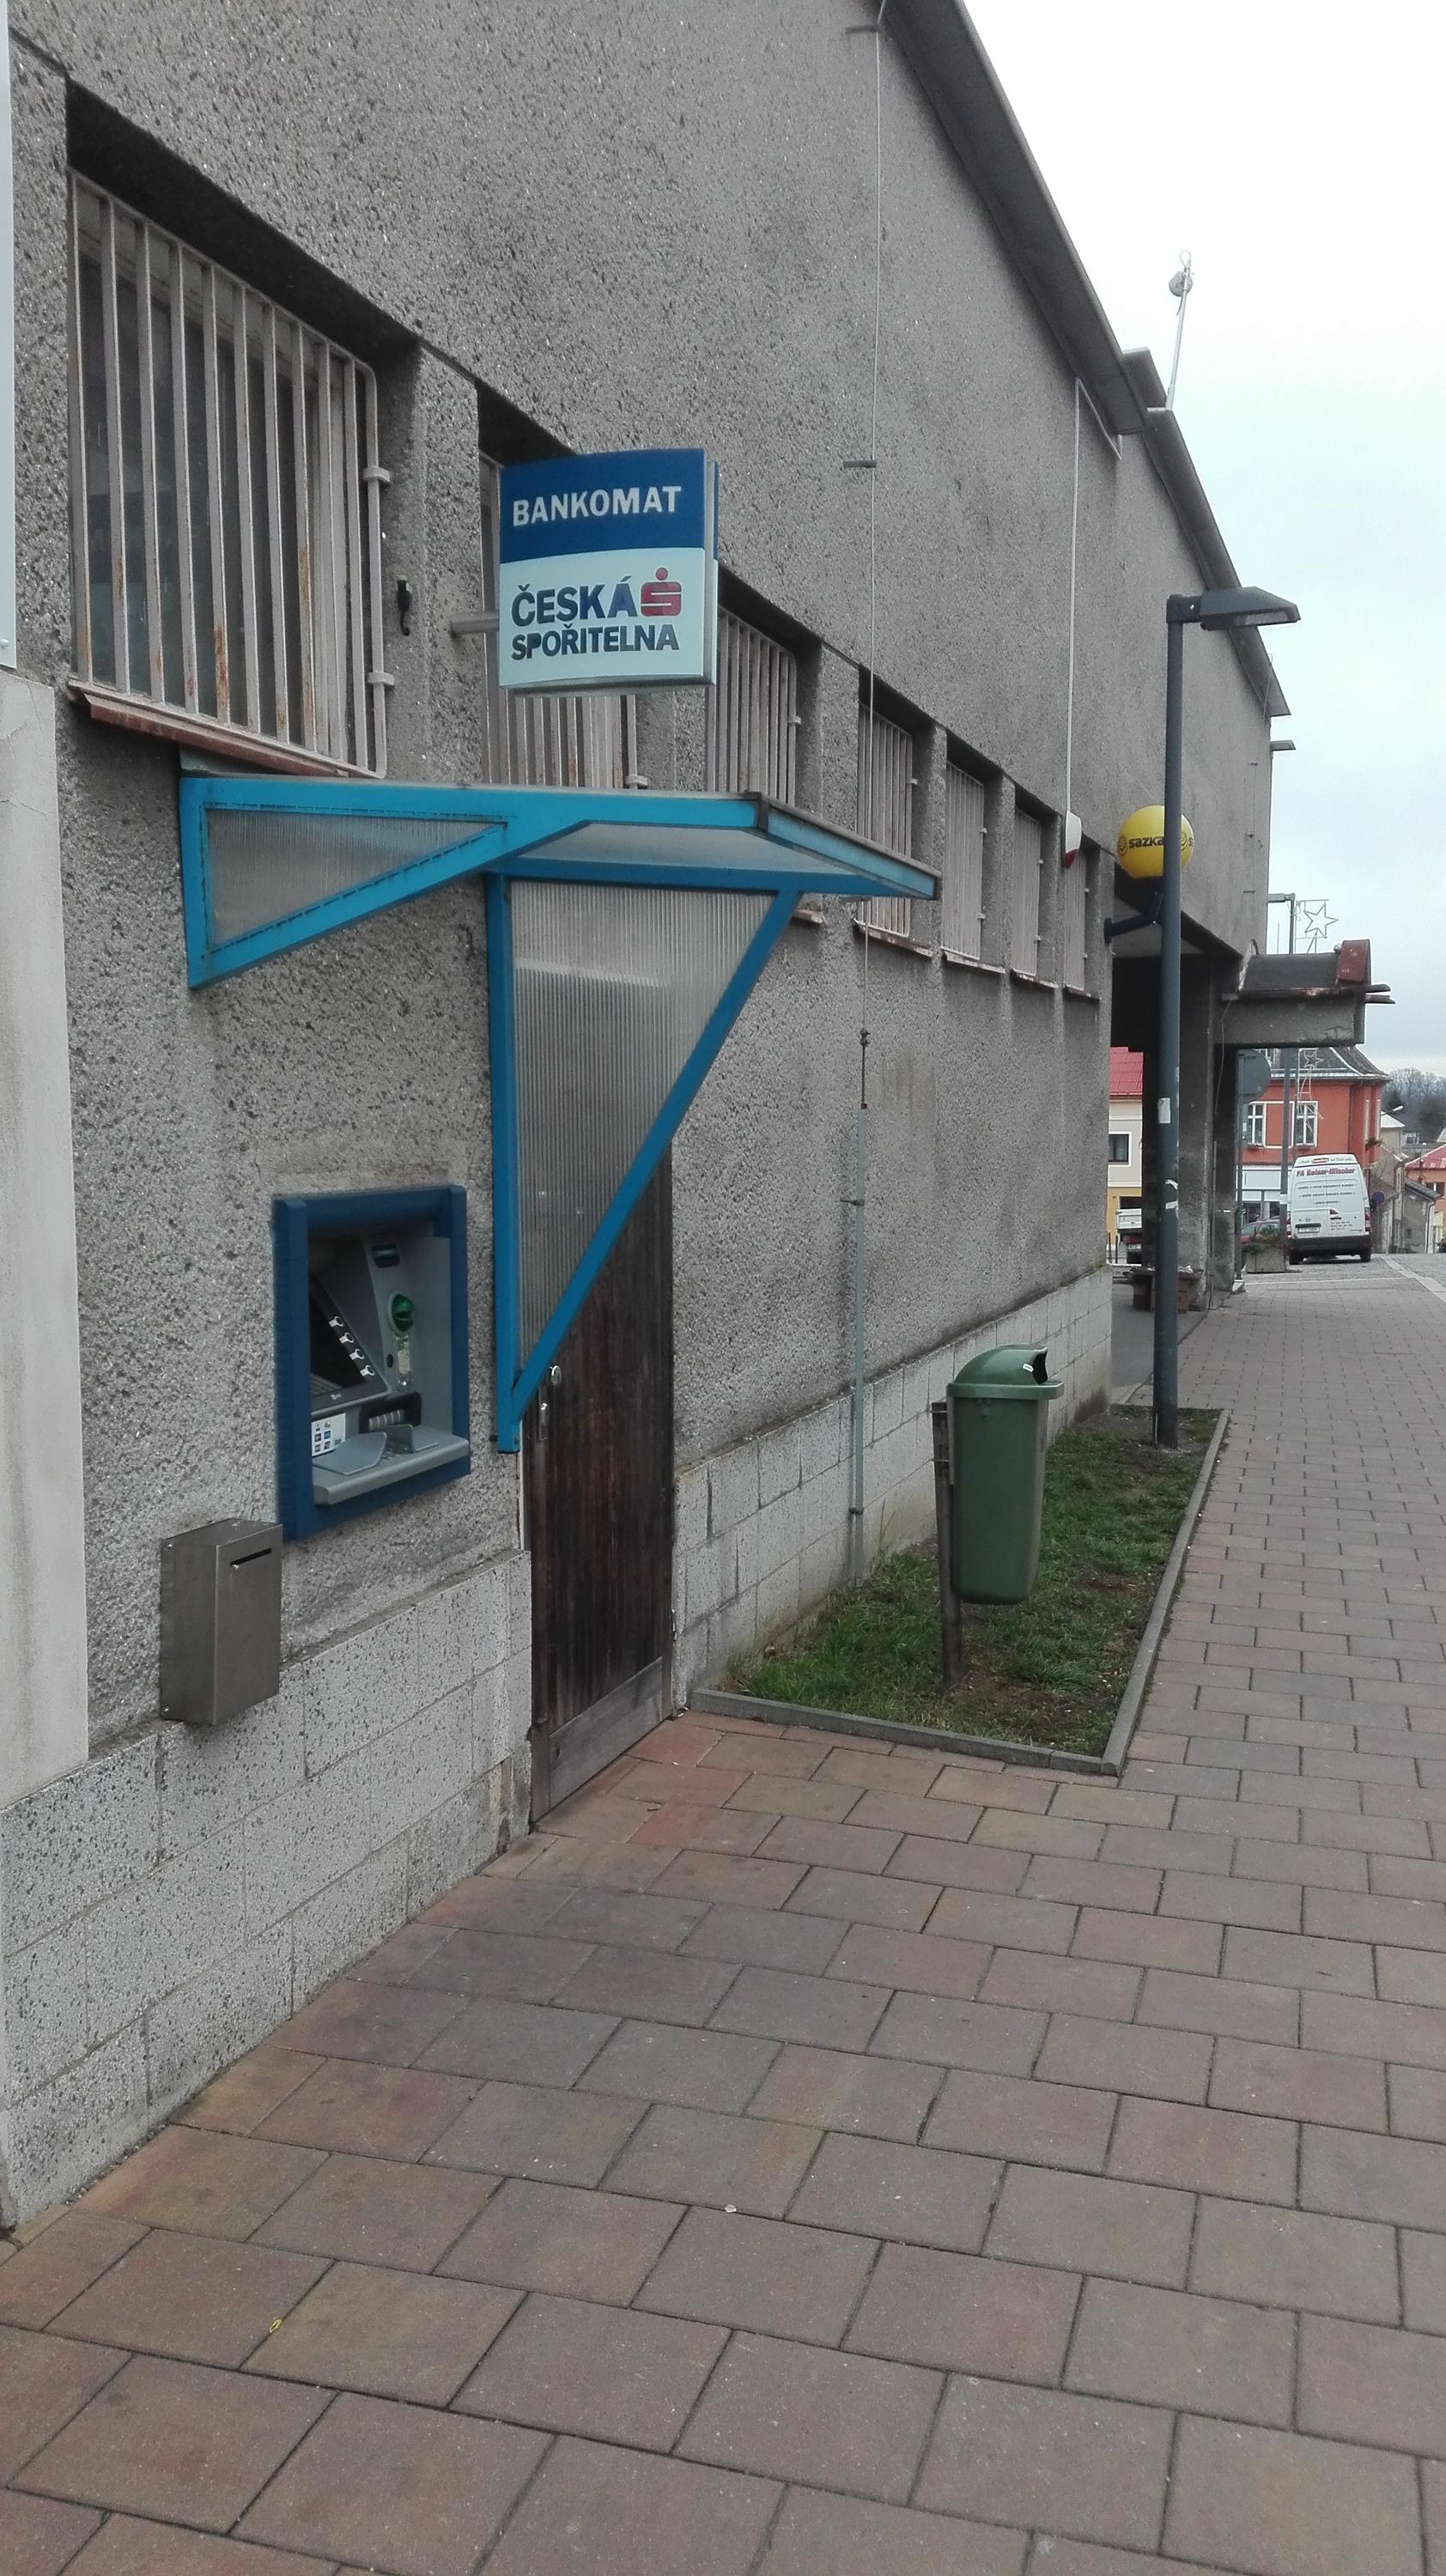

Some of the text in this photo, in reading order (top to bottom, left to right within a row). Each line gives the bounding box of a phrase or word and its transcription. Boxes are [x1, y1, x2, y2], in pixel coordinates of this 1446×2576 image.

[513, 485, 682, 527] BANKOMAT
[511, 575, 638, 627] ČESKÁ
[511, 623, 680, 661] SPOŘITELNA
